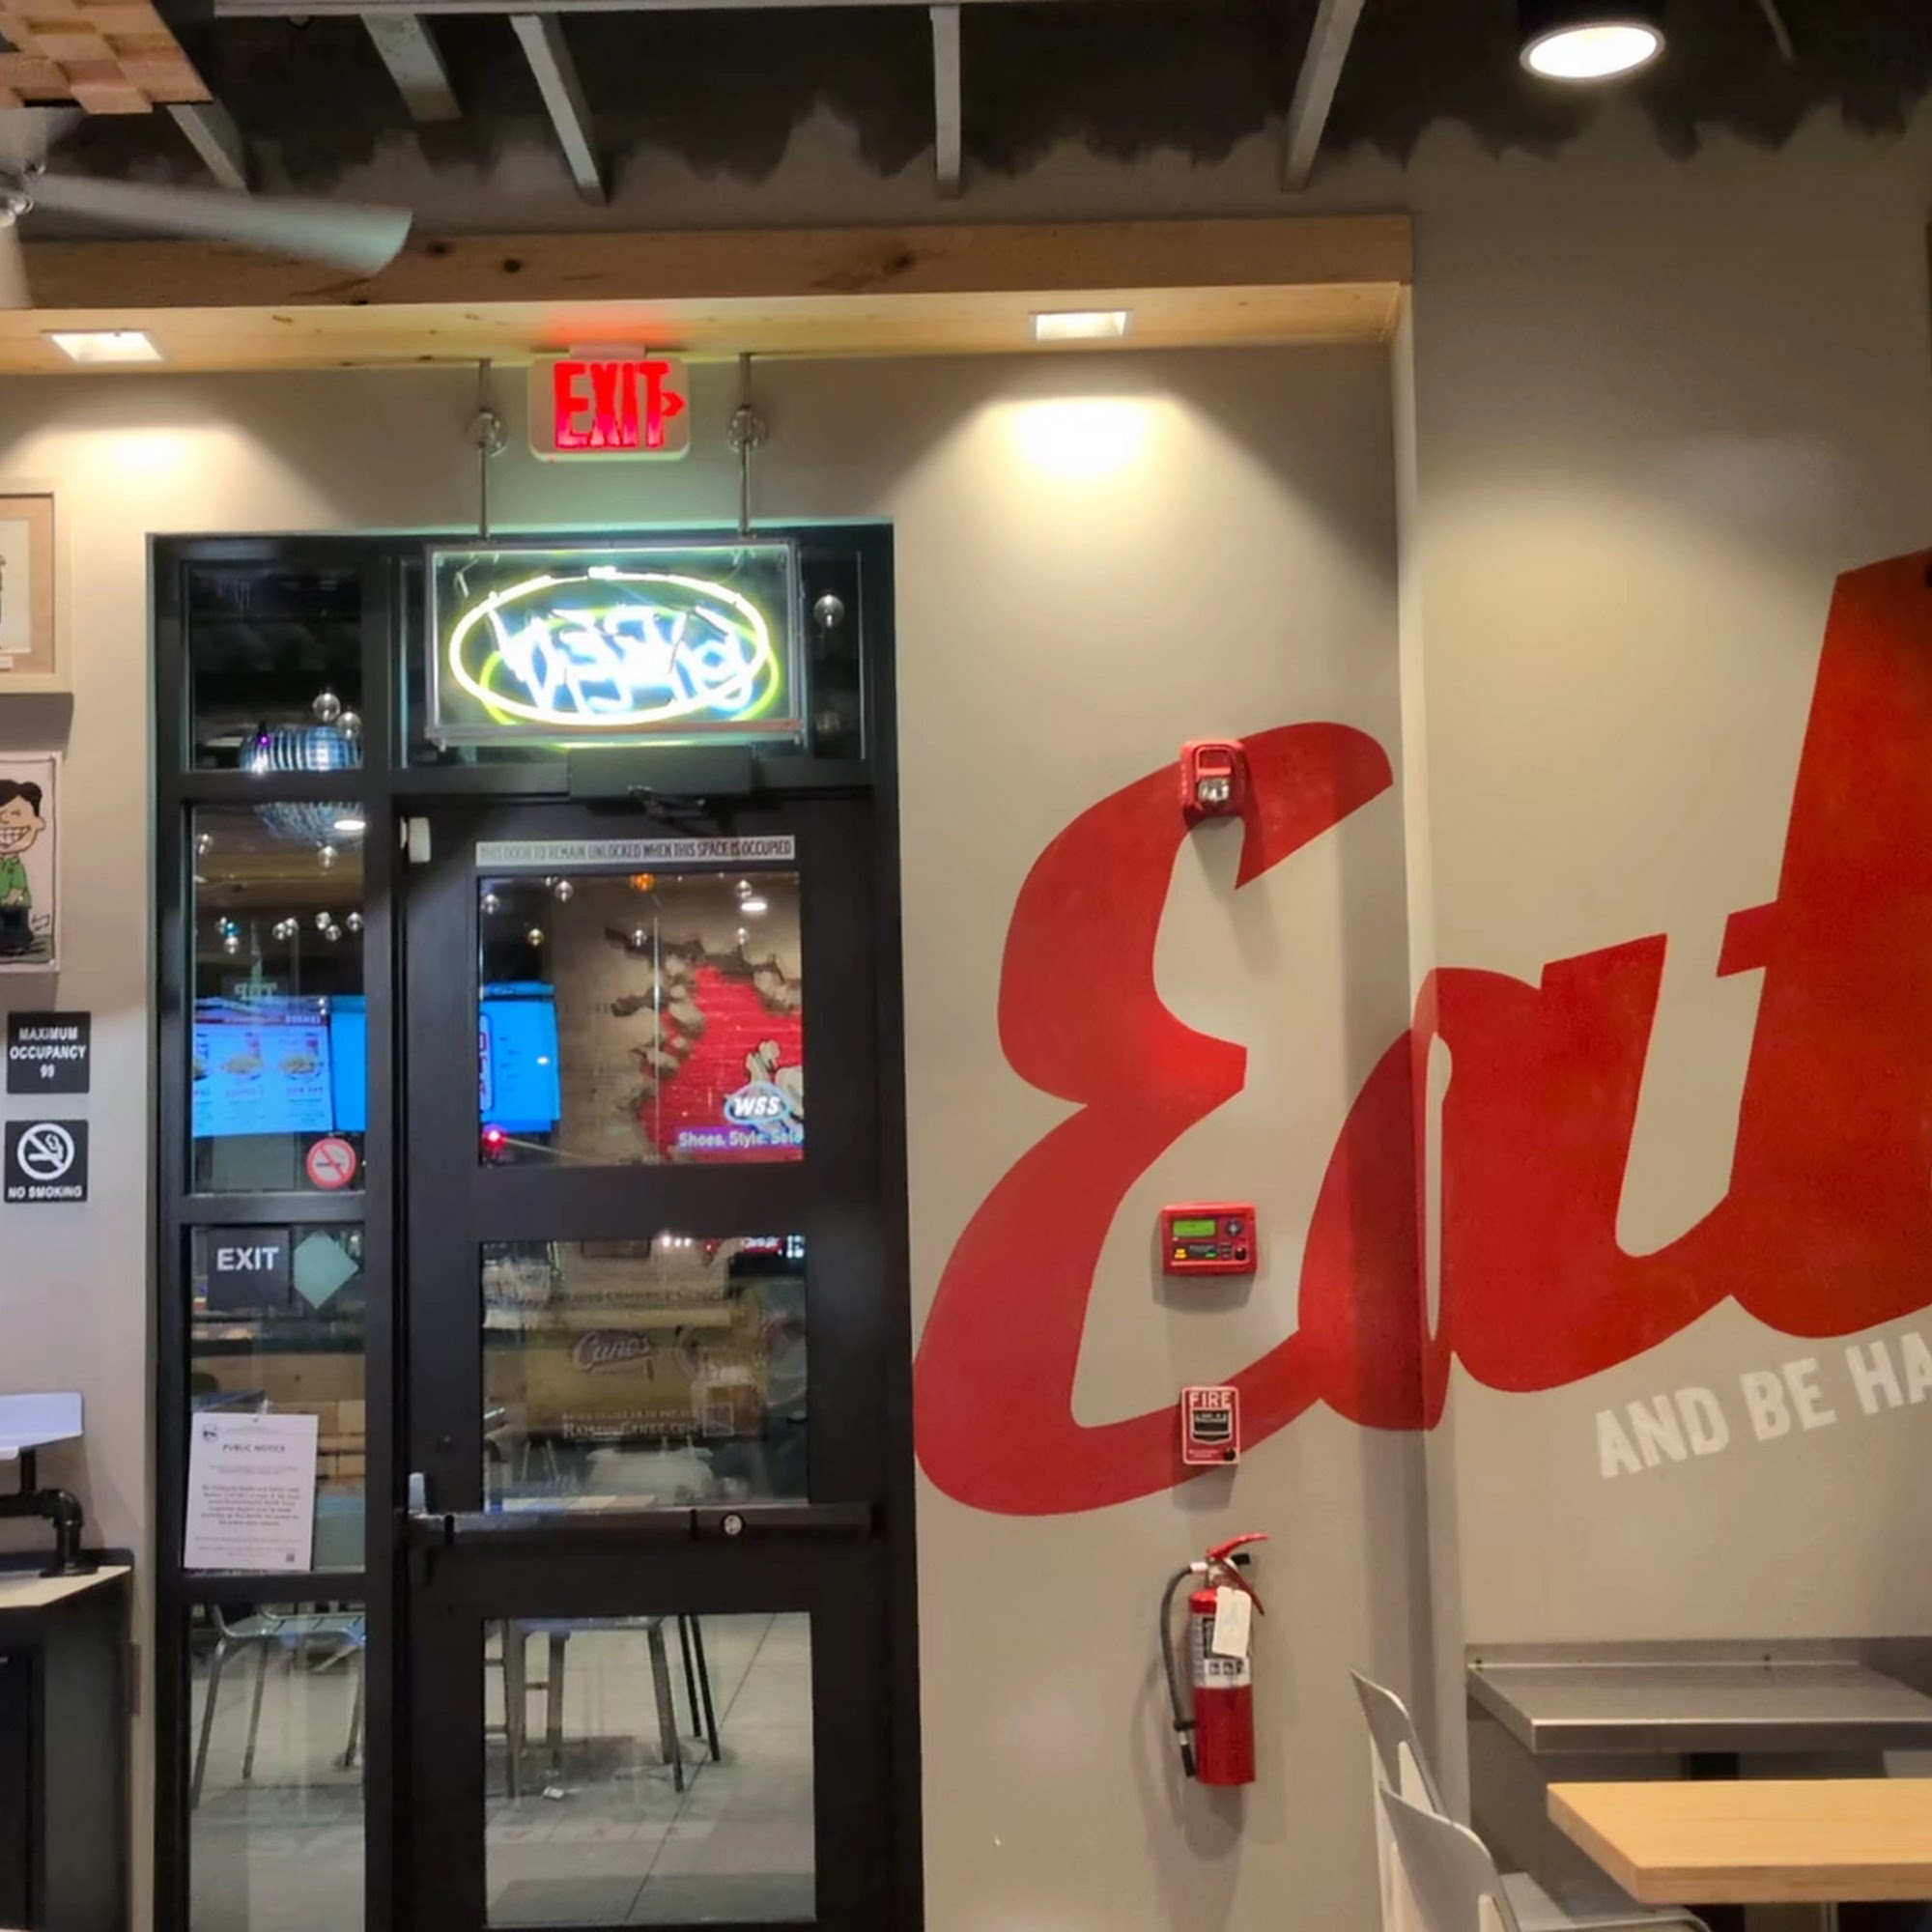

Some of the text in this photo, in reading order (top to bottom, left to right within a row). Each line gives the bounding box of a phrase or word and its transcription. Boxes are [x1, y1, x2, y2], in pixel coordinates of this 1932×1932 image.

[554, 362, 669, 448] EXIT
[549, 843, 585, 859] REMAIN
[588, 843, 641, 858] UNLOCKED
[643, 843, 671, 858] WHEN
[674, 842, 696, 857] THIS
[696, 842, 729, 857] SPACE
[731, 841, 740, 856] IS
[742, 840, 791, 856] OCCUPIED
[18, 1027, 78, 1040] MAXIMUM
[913, 551, 1932, 1516] Eat
[10, 1045, 87, 1060] OCCUPANCY
[40, 1064, 55, 1078] 99
[733, 1095, 780, 1117] WSS
[679, 1130, 727, 1148] Shoes.
[8, 1185, 83, 1199] NO SMOKING
[216, 1247, 279, 1271] EXIT
[1189, 1391, 1232, 1407] FIRE
[1595, 1387, 1730, 1479] AND
[1739, 1356, 1838, 1441] BE
[223, 1443, 286, 1453] PUBLIC NOTICE
